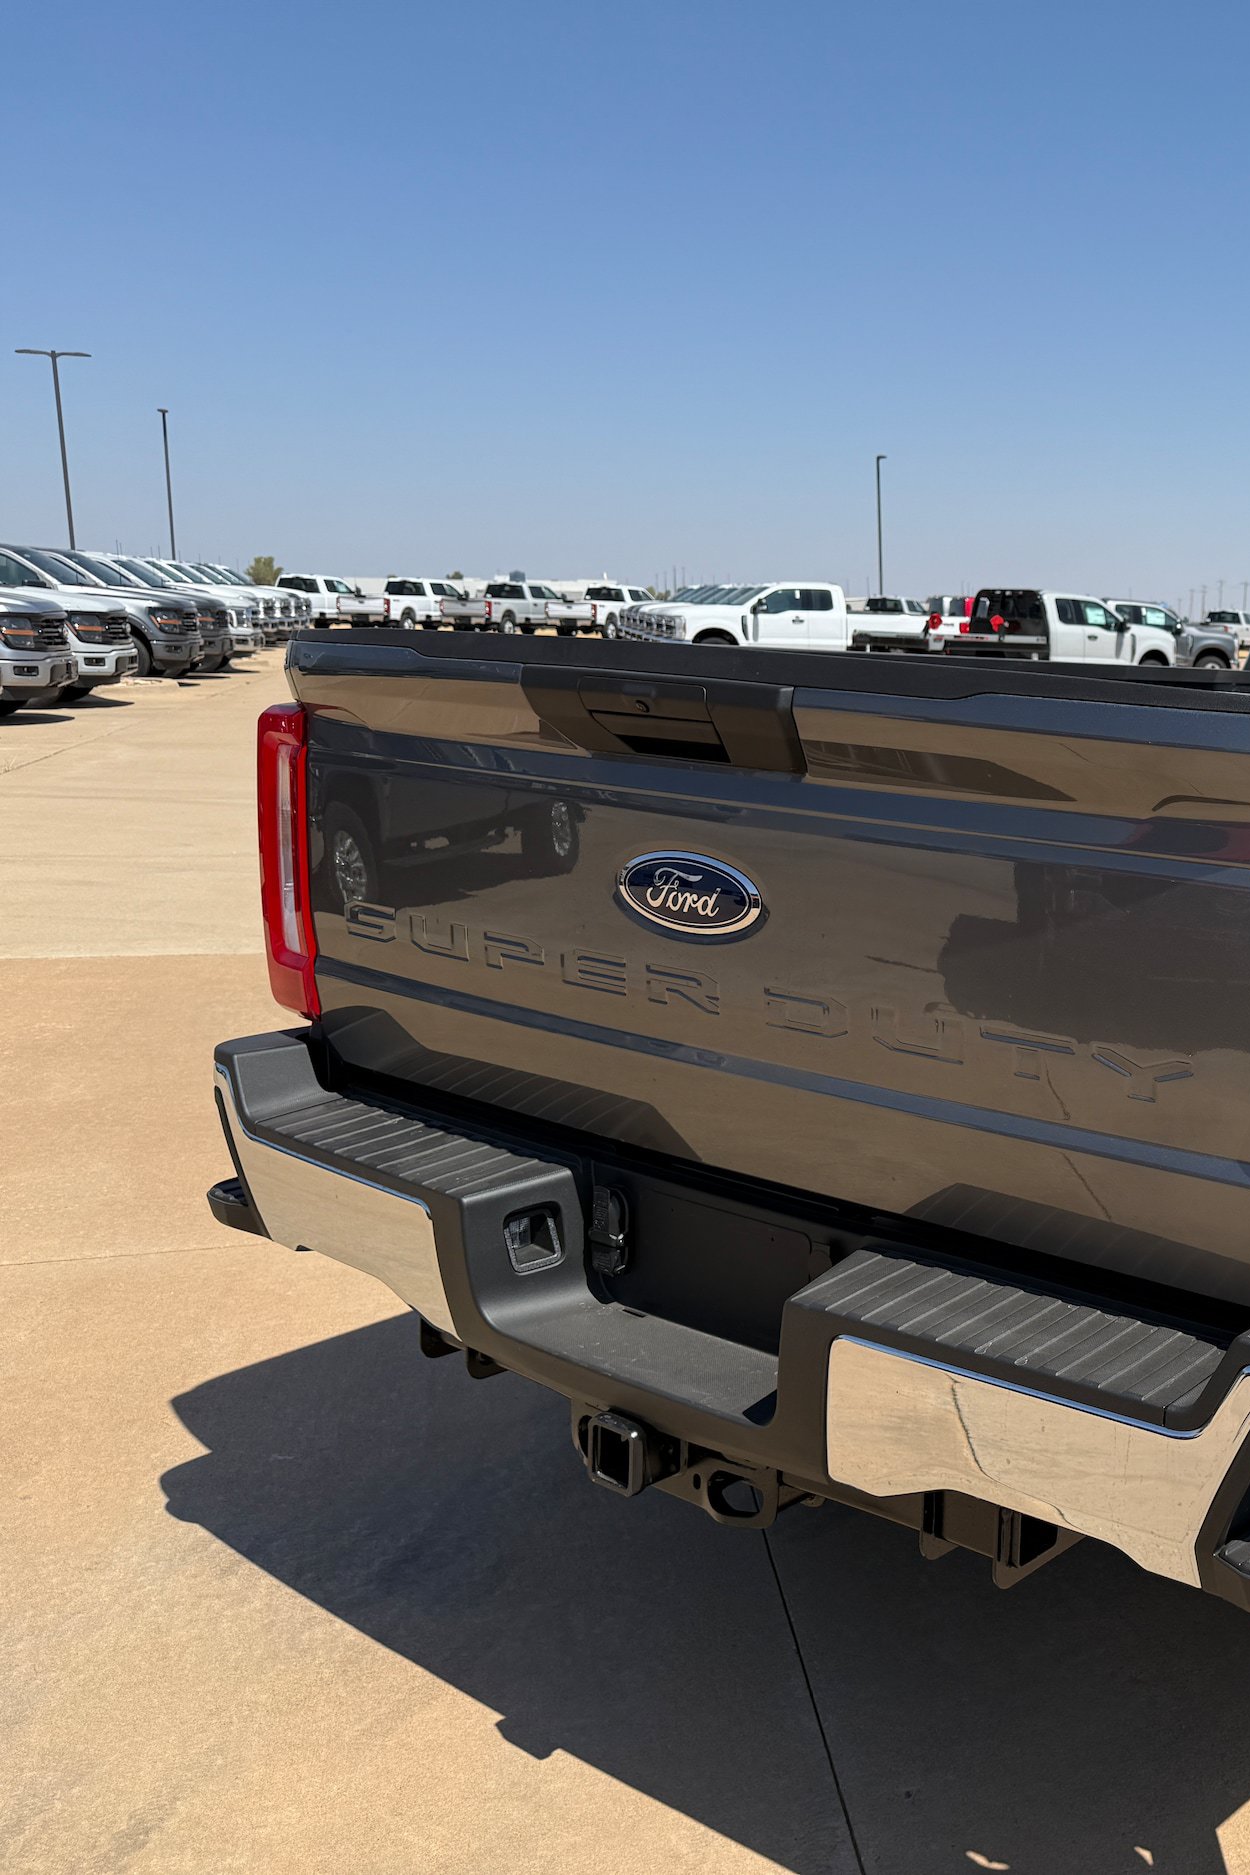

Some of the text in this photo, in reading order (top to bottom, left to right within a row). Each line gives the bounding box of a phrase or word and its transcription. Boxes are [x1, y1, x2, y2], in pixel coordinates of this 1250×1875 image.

[646, 867, 721, 917] Ford
[344, 900, 1194, 1103] SUPER DUTY
